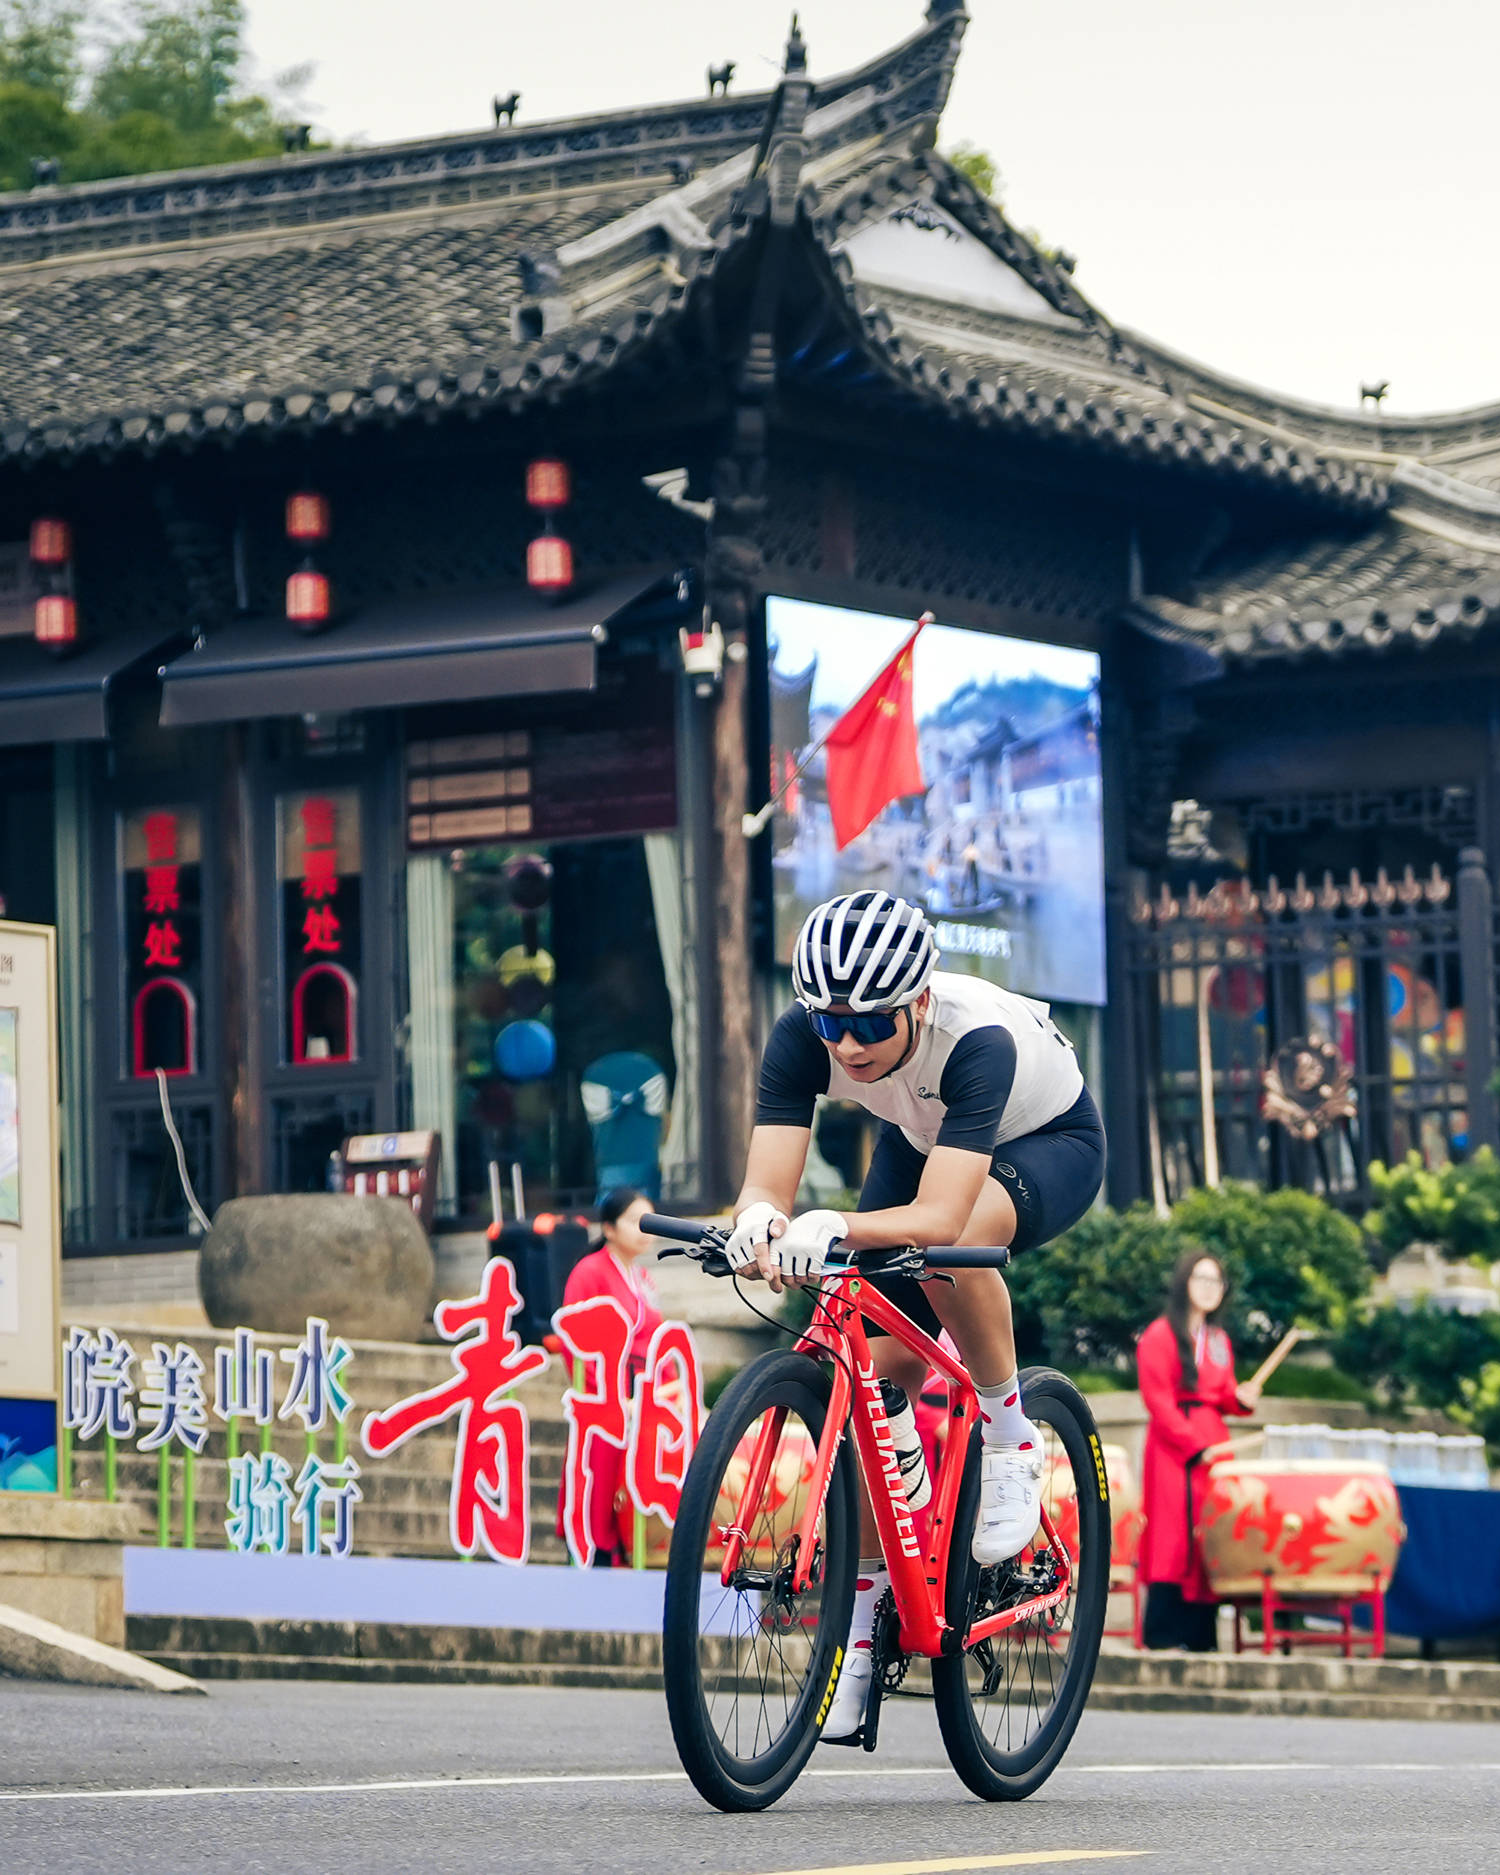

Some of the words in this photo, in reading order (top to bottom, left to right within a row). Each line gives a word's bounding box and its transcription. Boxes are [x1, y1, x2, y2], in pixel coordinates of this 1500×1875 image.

[63, 1316, 354, 1453] 皖美山水
[361, 1256, 703, 1569] 青阳
[225, 1452, 363, 1560] 骑行
